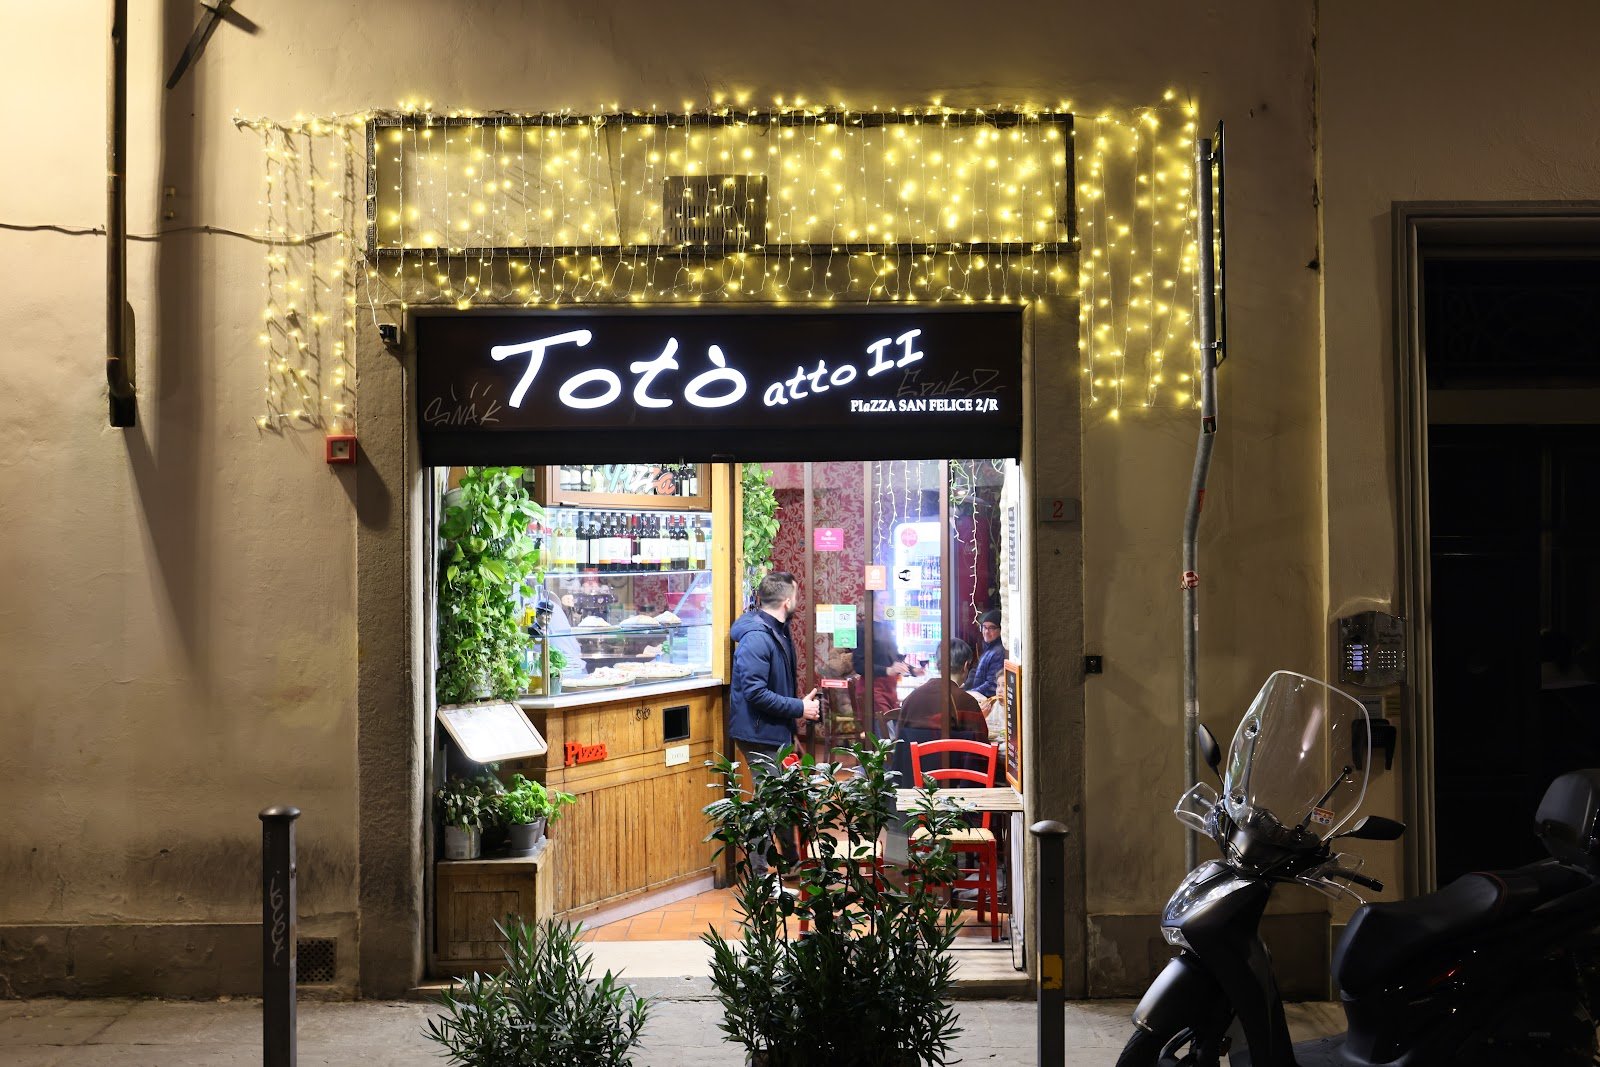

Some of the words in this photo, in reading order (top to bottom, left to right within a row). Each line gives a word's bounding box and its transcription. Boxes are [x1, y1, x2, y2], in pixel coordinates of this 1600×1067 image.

[490, 329, 748, 410] Totò
[763, 359, 857, 407] atto
[866, 328, 924, 377] II
[898, 399, 927, 412] SAN
[928, 398, 973, 412] FELICE
[975, 397, 999, 413] 2/R
[1052, 500, 1064, 518] 2
[564, 741, 608, 767] Pizza
